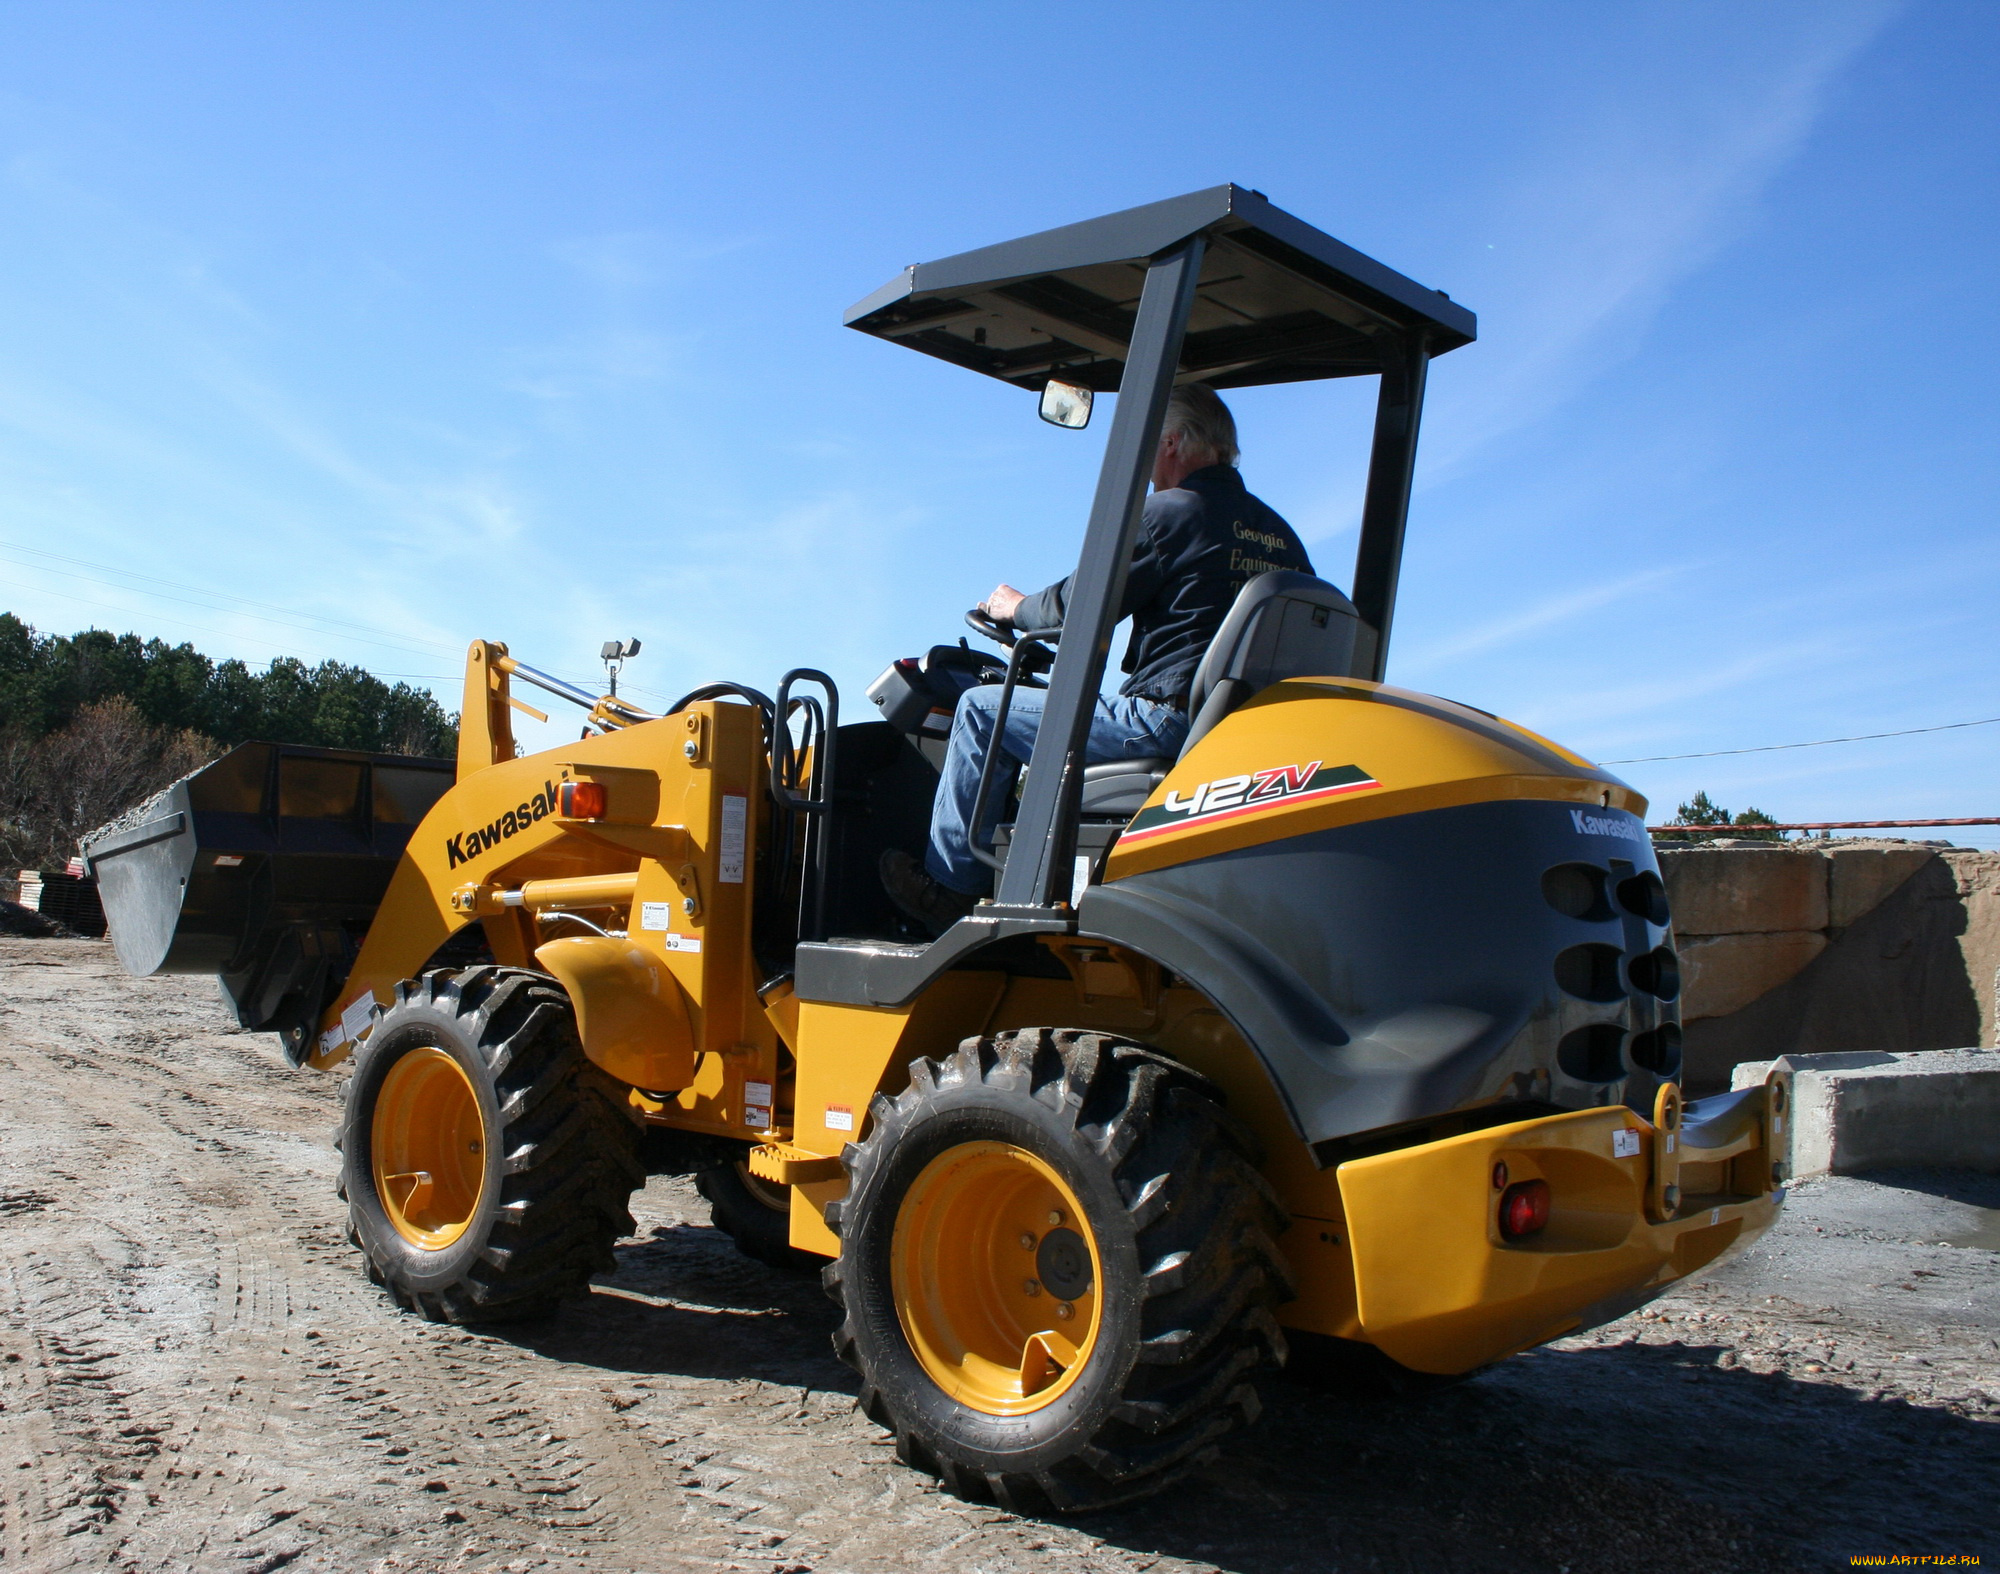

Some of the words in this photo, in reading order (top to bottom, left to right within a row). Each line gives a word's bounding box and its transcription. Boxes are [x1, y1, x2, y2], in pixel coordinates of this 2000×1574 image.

[1233, 520, 1287, 552] Georgia
[1230, 549, 1299, 577] Equipm
[1164, 760, 1322, 815] 42ZV
[1570, 809, 1640, 842] Kawasaki
